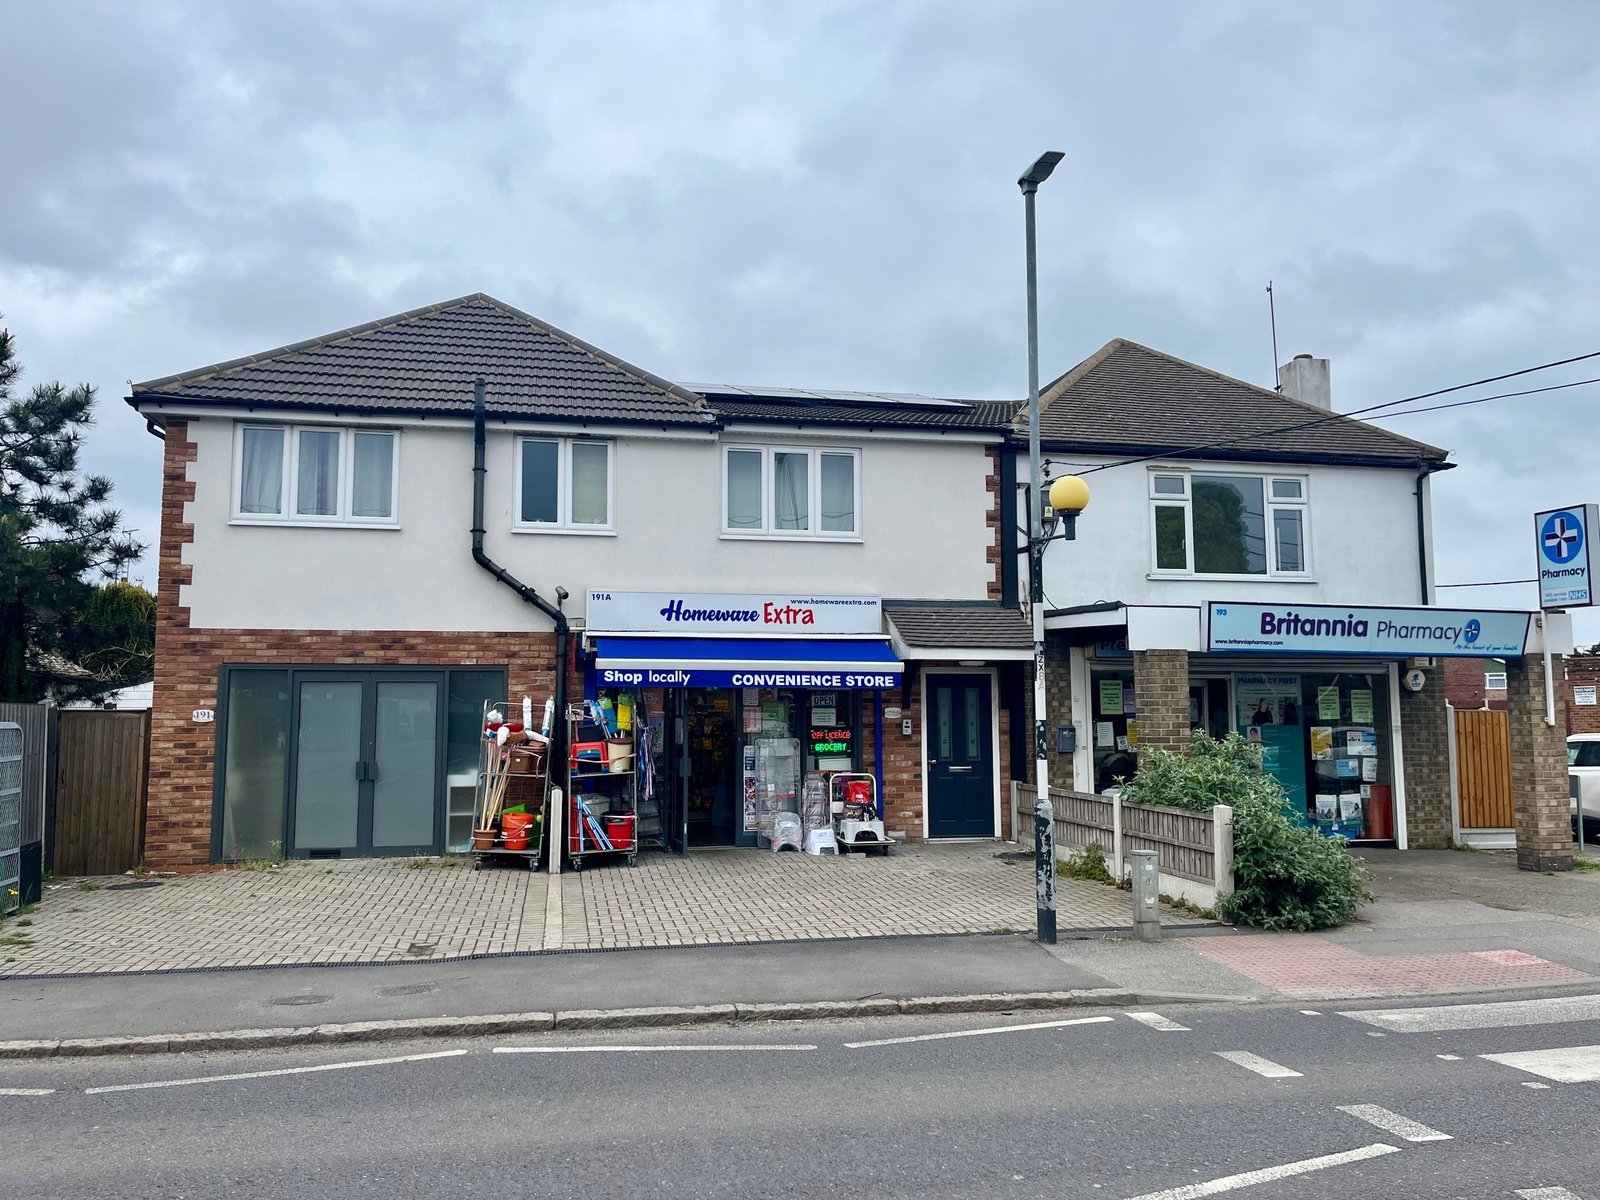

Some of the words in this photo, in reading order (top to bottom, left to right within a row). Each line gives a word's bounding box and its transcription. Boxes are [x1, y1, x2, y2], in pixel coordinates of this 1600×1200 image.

[1542, 567, 1586, 579] Pharmacy
[592, 593, 612, 601] 191A
[1569, 590, 1587, 600] NHS
[790, 598, 877, 606] www.homewareextra.com
[660, 599, 760, 622] Homeware
[763, 602, 815, 625] Extra
[1260, 611, 1369, 638] Britannia
[1377, 620, 1463, 644] Pharmacy
[1214, 638, 1284, 647] www.britanniapharmacy.com
[603, 670, 643, 684] Shop
[648, 670, 691, 686] locally
[732, 674, 842, 687] CONVENIENCE
[845, 675, 894, 688] STORE
[814, 696, 834, 705] OPEN
[196, 711, 210, 719] 191
[814, 742, 847, 752] GROCERY
